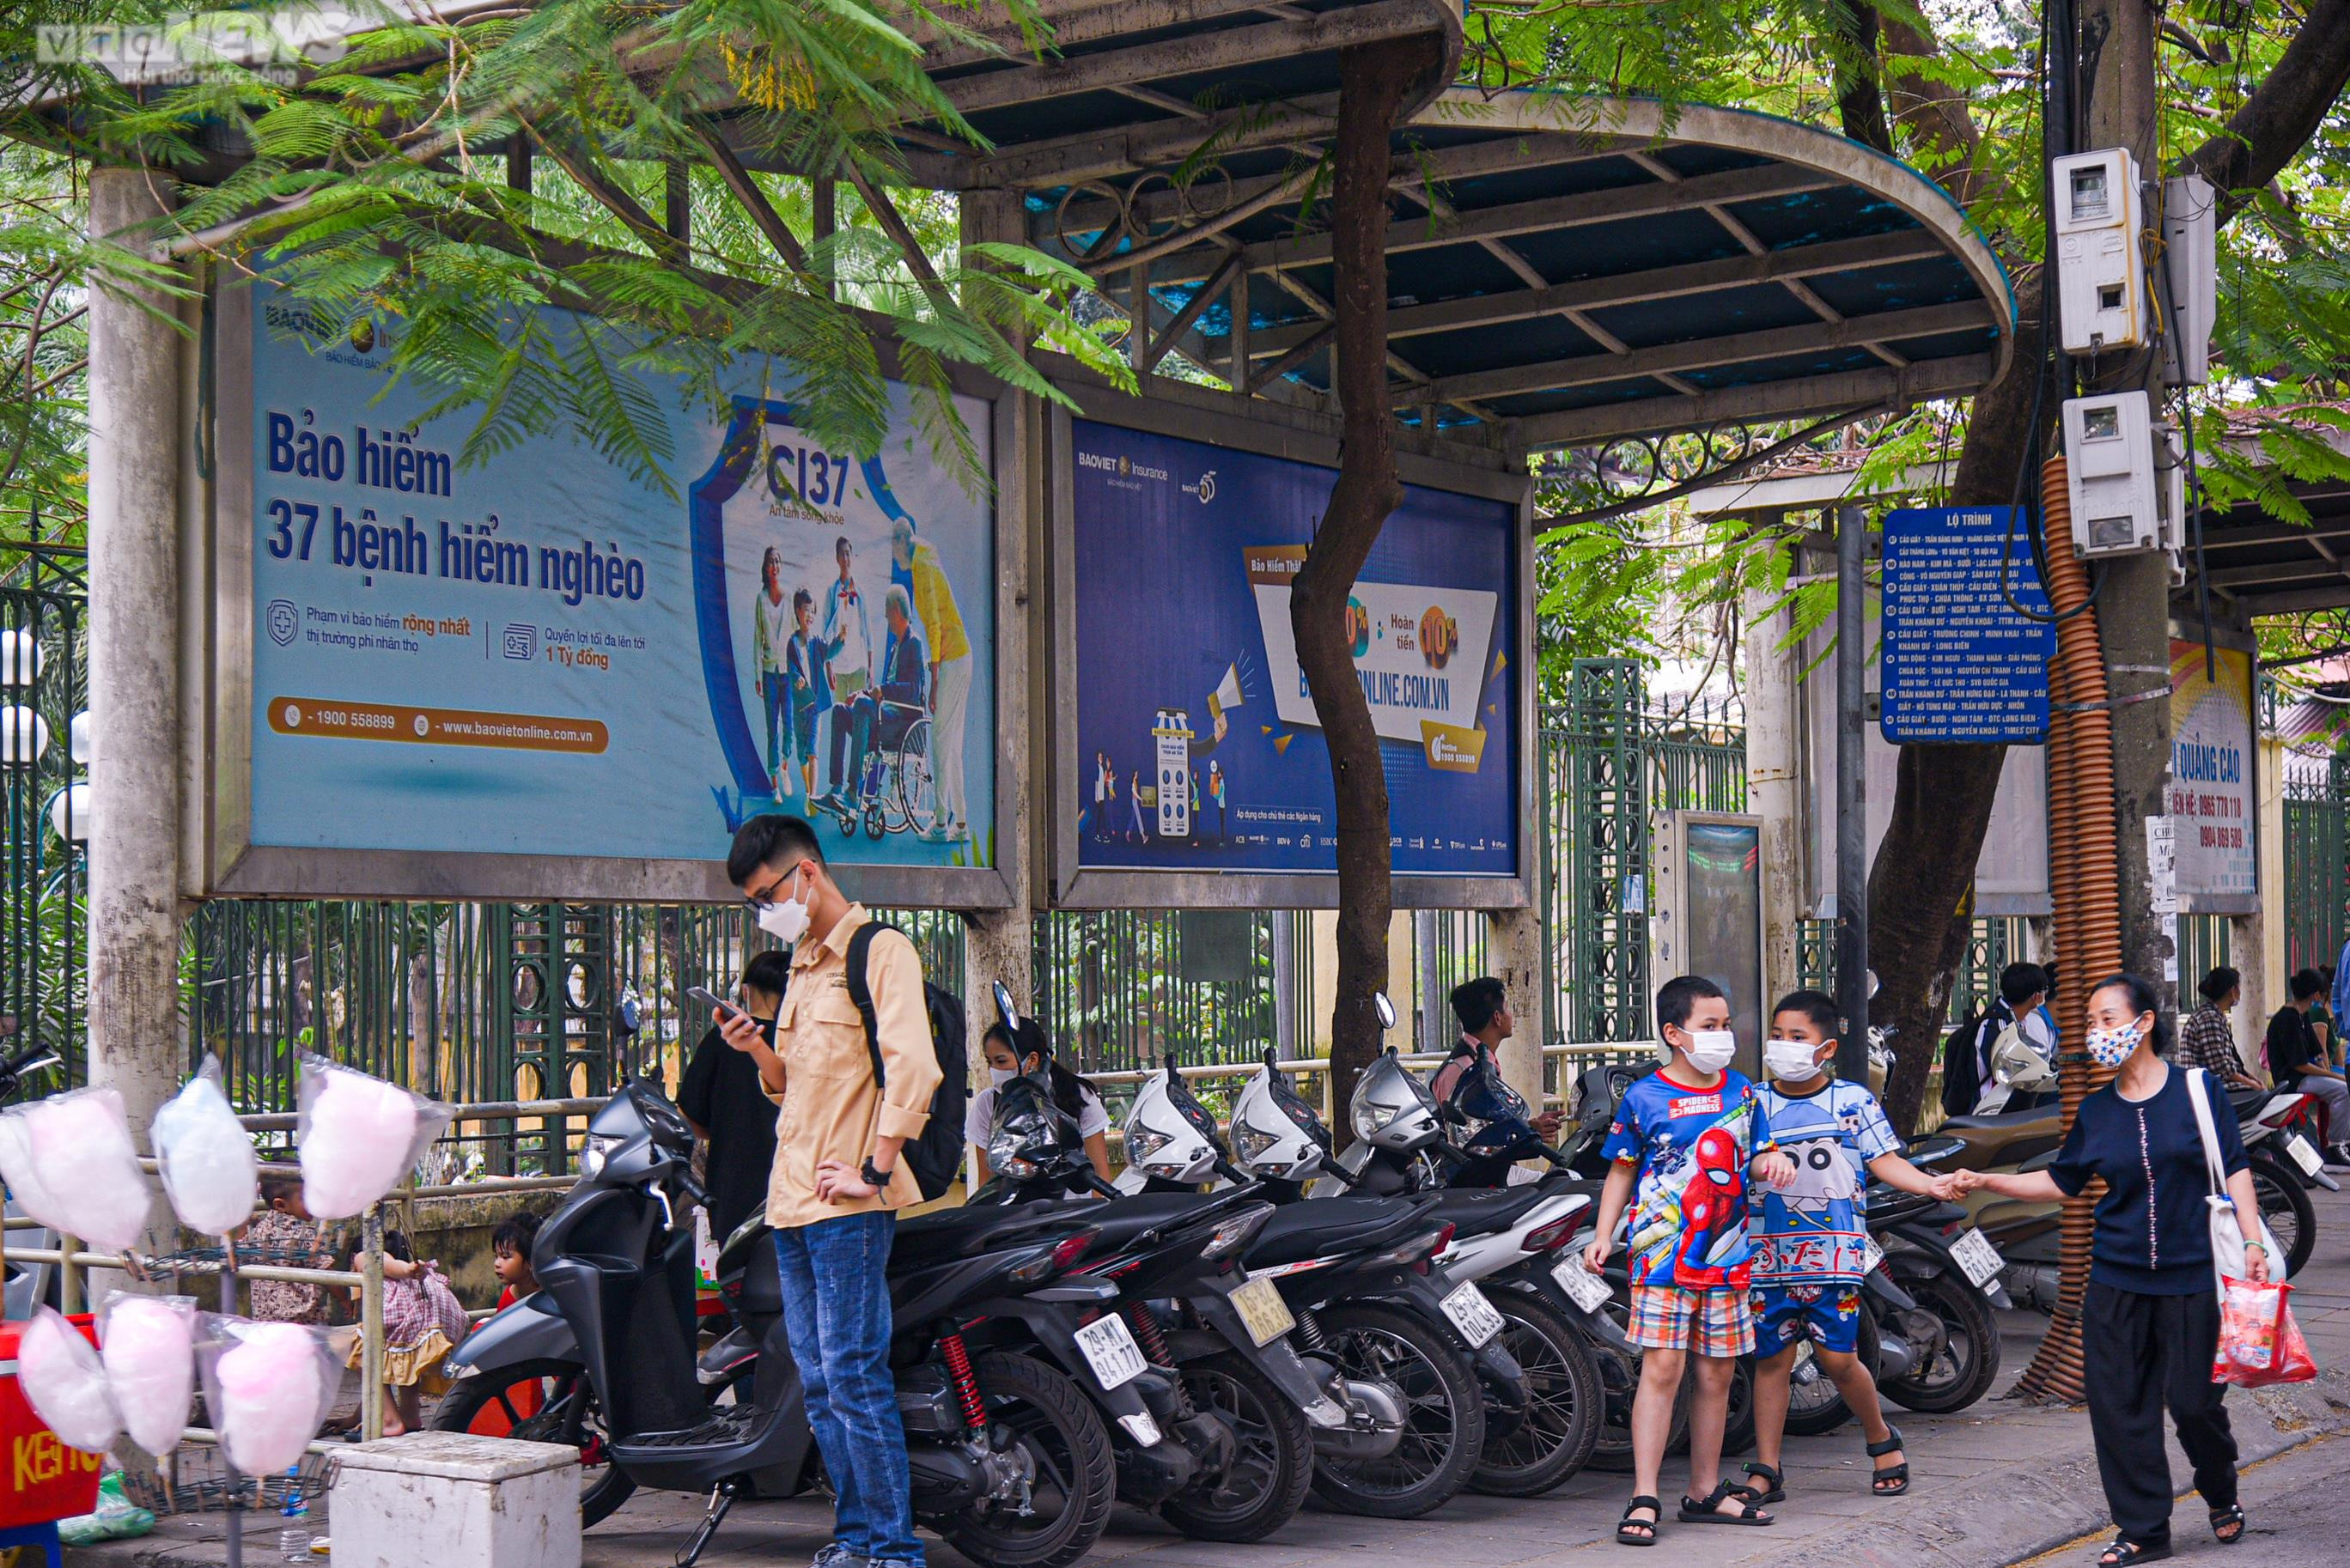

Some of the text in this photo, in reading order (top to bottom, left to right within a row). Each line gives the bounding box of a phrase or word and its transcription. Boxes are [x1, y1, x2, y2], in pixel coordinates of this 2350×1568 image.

[268, 409, 451, 497] Bảo hiểm
[767, 445, 849, 507] CI37
[1079, 452, 1168, 481] BAOVIET Insurance
[769, 504, 781, 516] An
[783, 507, 799, 519] tâm
[801, 508, 822, 525] sống
[1947, 511, 1992, 528] LỘ TRÌNH
[268, 499, 644, 605] 37 bệnh hiểm nghèo
[1251, 558, 1265, 572] Bảo
[1267, 557, 1284, 572] Hiểm
[307, 607, 471, 636] Phạm vi bảo hiểm rộng nhất
[1391, 613, 1414, 630] Hoàn
[307, 629, 418, 654] thị trường phi nhân thọ
[545, 628, 645, 648] Quyền lợi tối đa lên tới
[1397, 635, 1414, 651] tiền
[1422, 617, 1458, 655] 10%
[546, 646, 609, 671] 1 Tỷ đồng
[317, 710, 395, 729] 1900 558899
[443, 720, 593, 743] www.baovietonline.com.vn
[1441, 753, 1453, 763] 1900
[2181, 732, 2217, 782] QUẢNG
[2220, 740, 2240, 783] CÁO
[1237, 807, 1244, 819] Áp
[1245, 811, 1257, 820] dụng
[1296, 812, 1308, 822] Ngân
[1309, 813, 1321, 823] hàng
[2173, 788, 2184, 815] IÊN
[2186, 788, 2196, 821] HỆ:
[2200, 793, 2215, 817] 0965
[2230, 796, 2241, 817] 118
[2201, 824, 2242, 848] 0904 869 589
[1678, 1096, 1708, 1107] SPIDER
[1683, 1103, 1720, 1115] MADNESS
[1966, 1249, 2000, 1285] 781.45
[1096, 1344, 1139, 1383] 941.77
